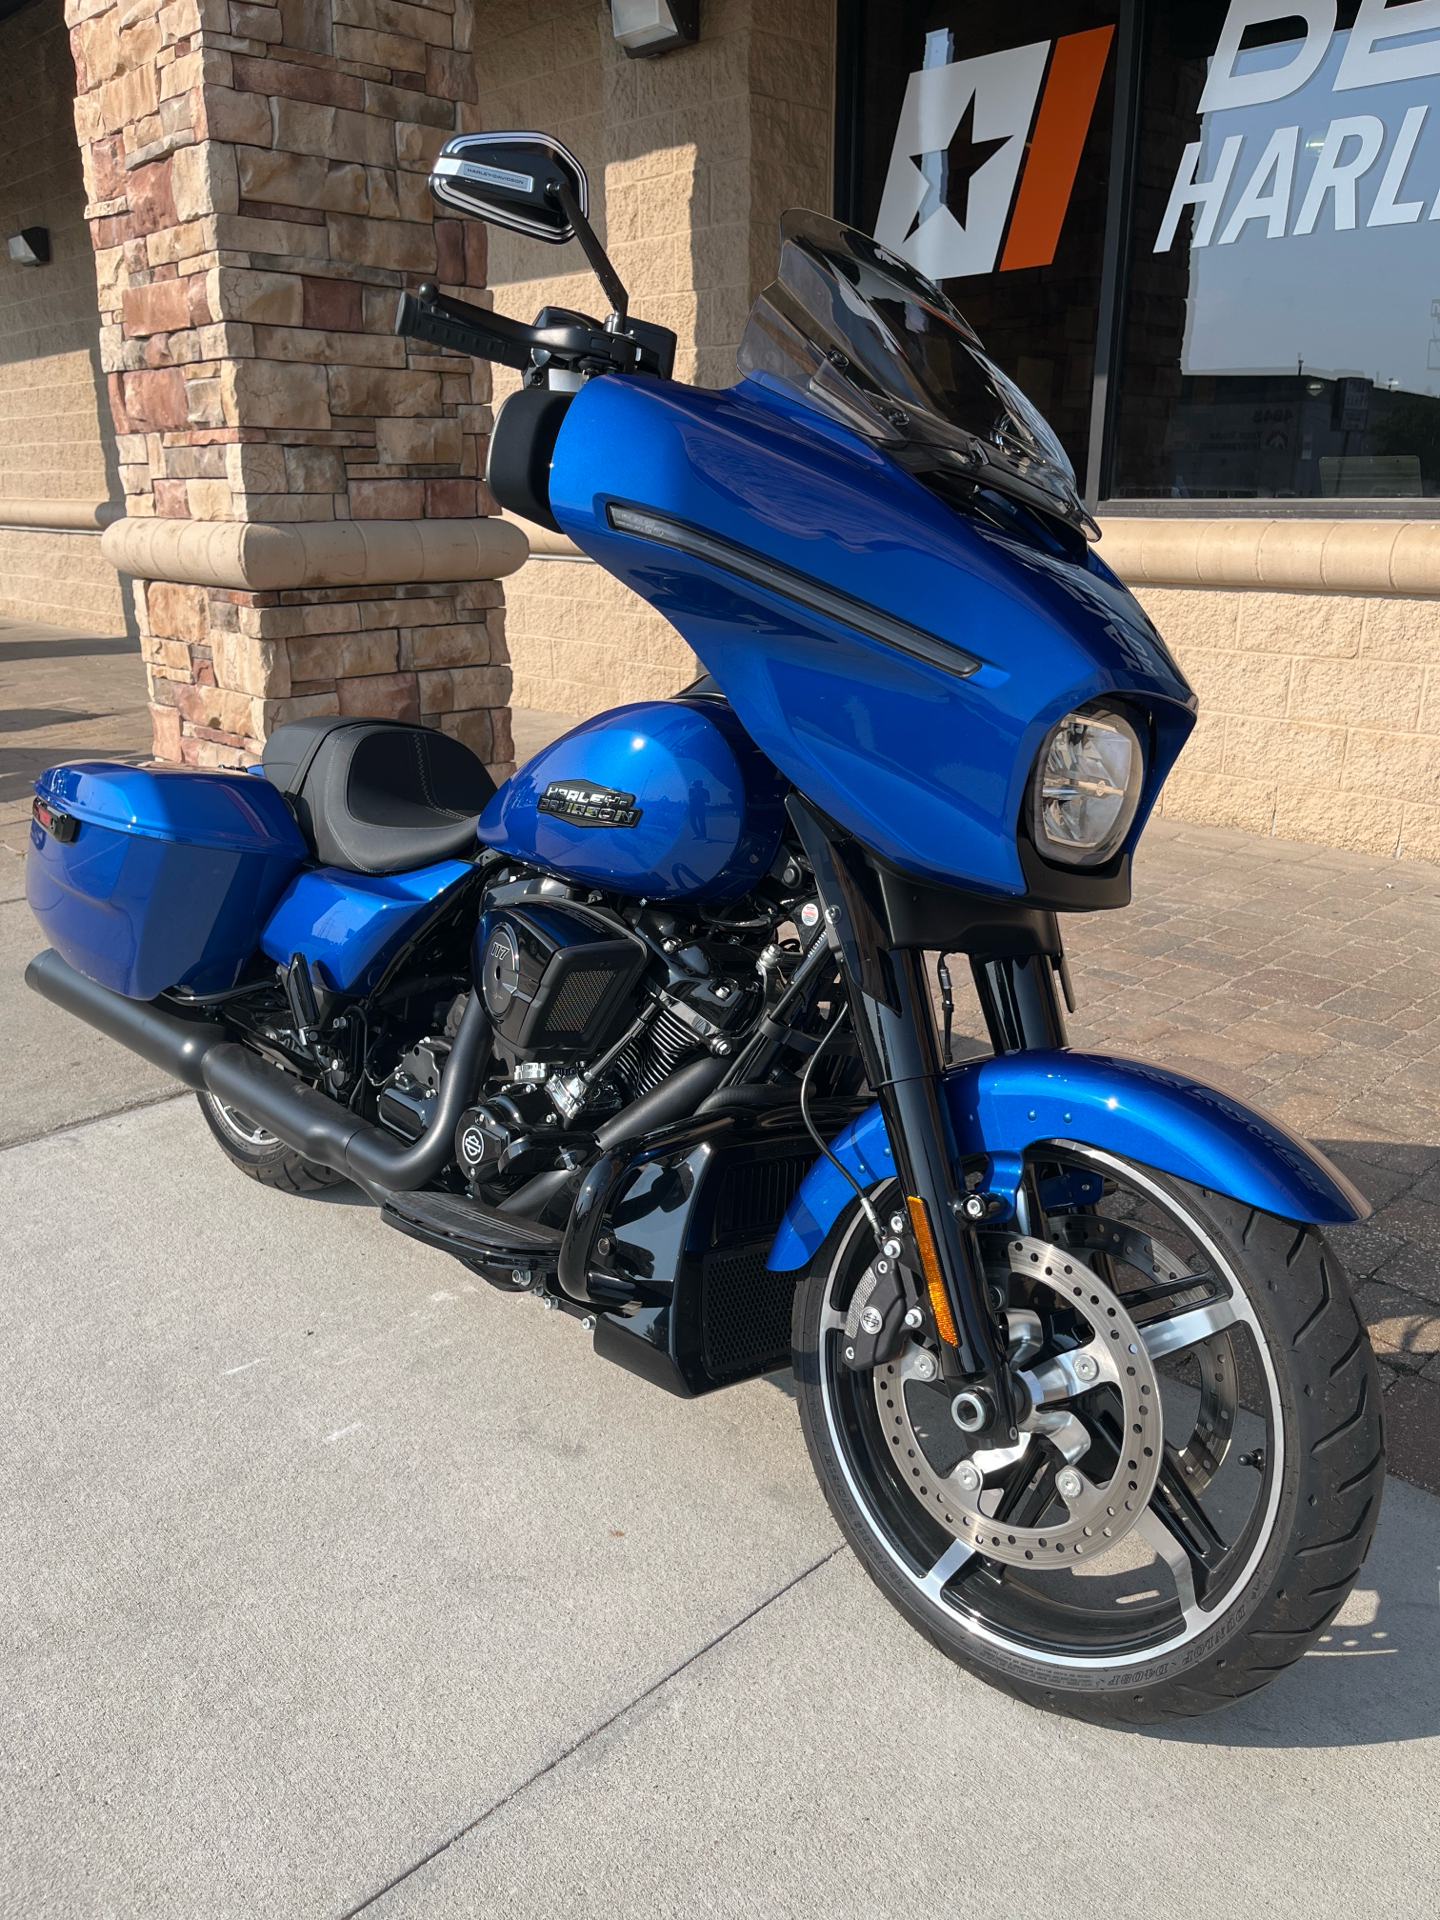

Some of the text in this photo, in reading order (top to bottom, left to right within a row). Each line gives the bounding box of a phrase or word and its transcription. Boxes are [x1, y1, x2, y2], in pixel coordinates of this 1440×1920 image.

[467, 168, 524, 185] HARLEY-DAVIDSON
[1153, 105, 1440, 253] HARL
[540, 797, 634, 822] DAVIDSON
[491, 941, 510, 960] 117
[1182, 1605, 1248, 1665] DUNLOP
[1107, 1663, 1170, 1686] D408F
